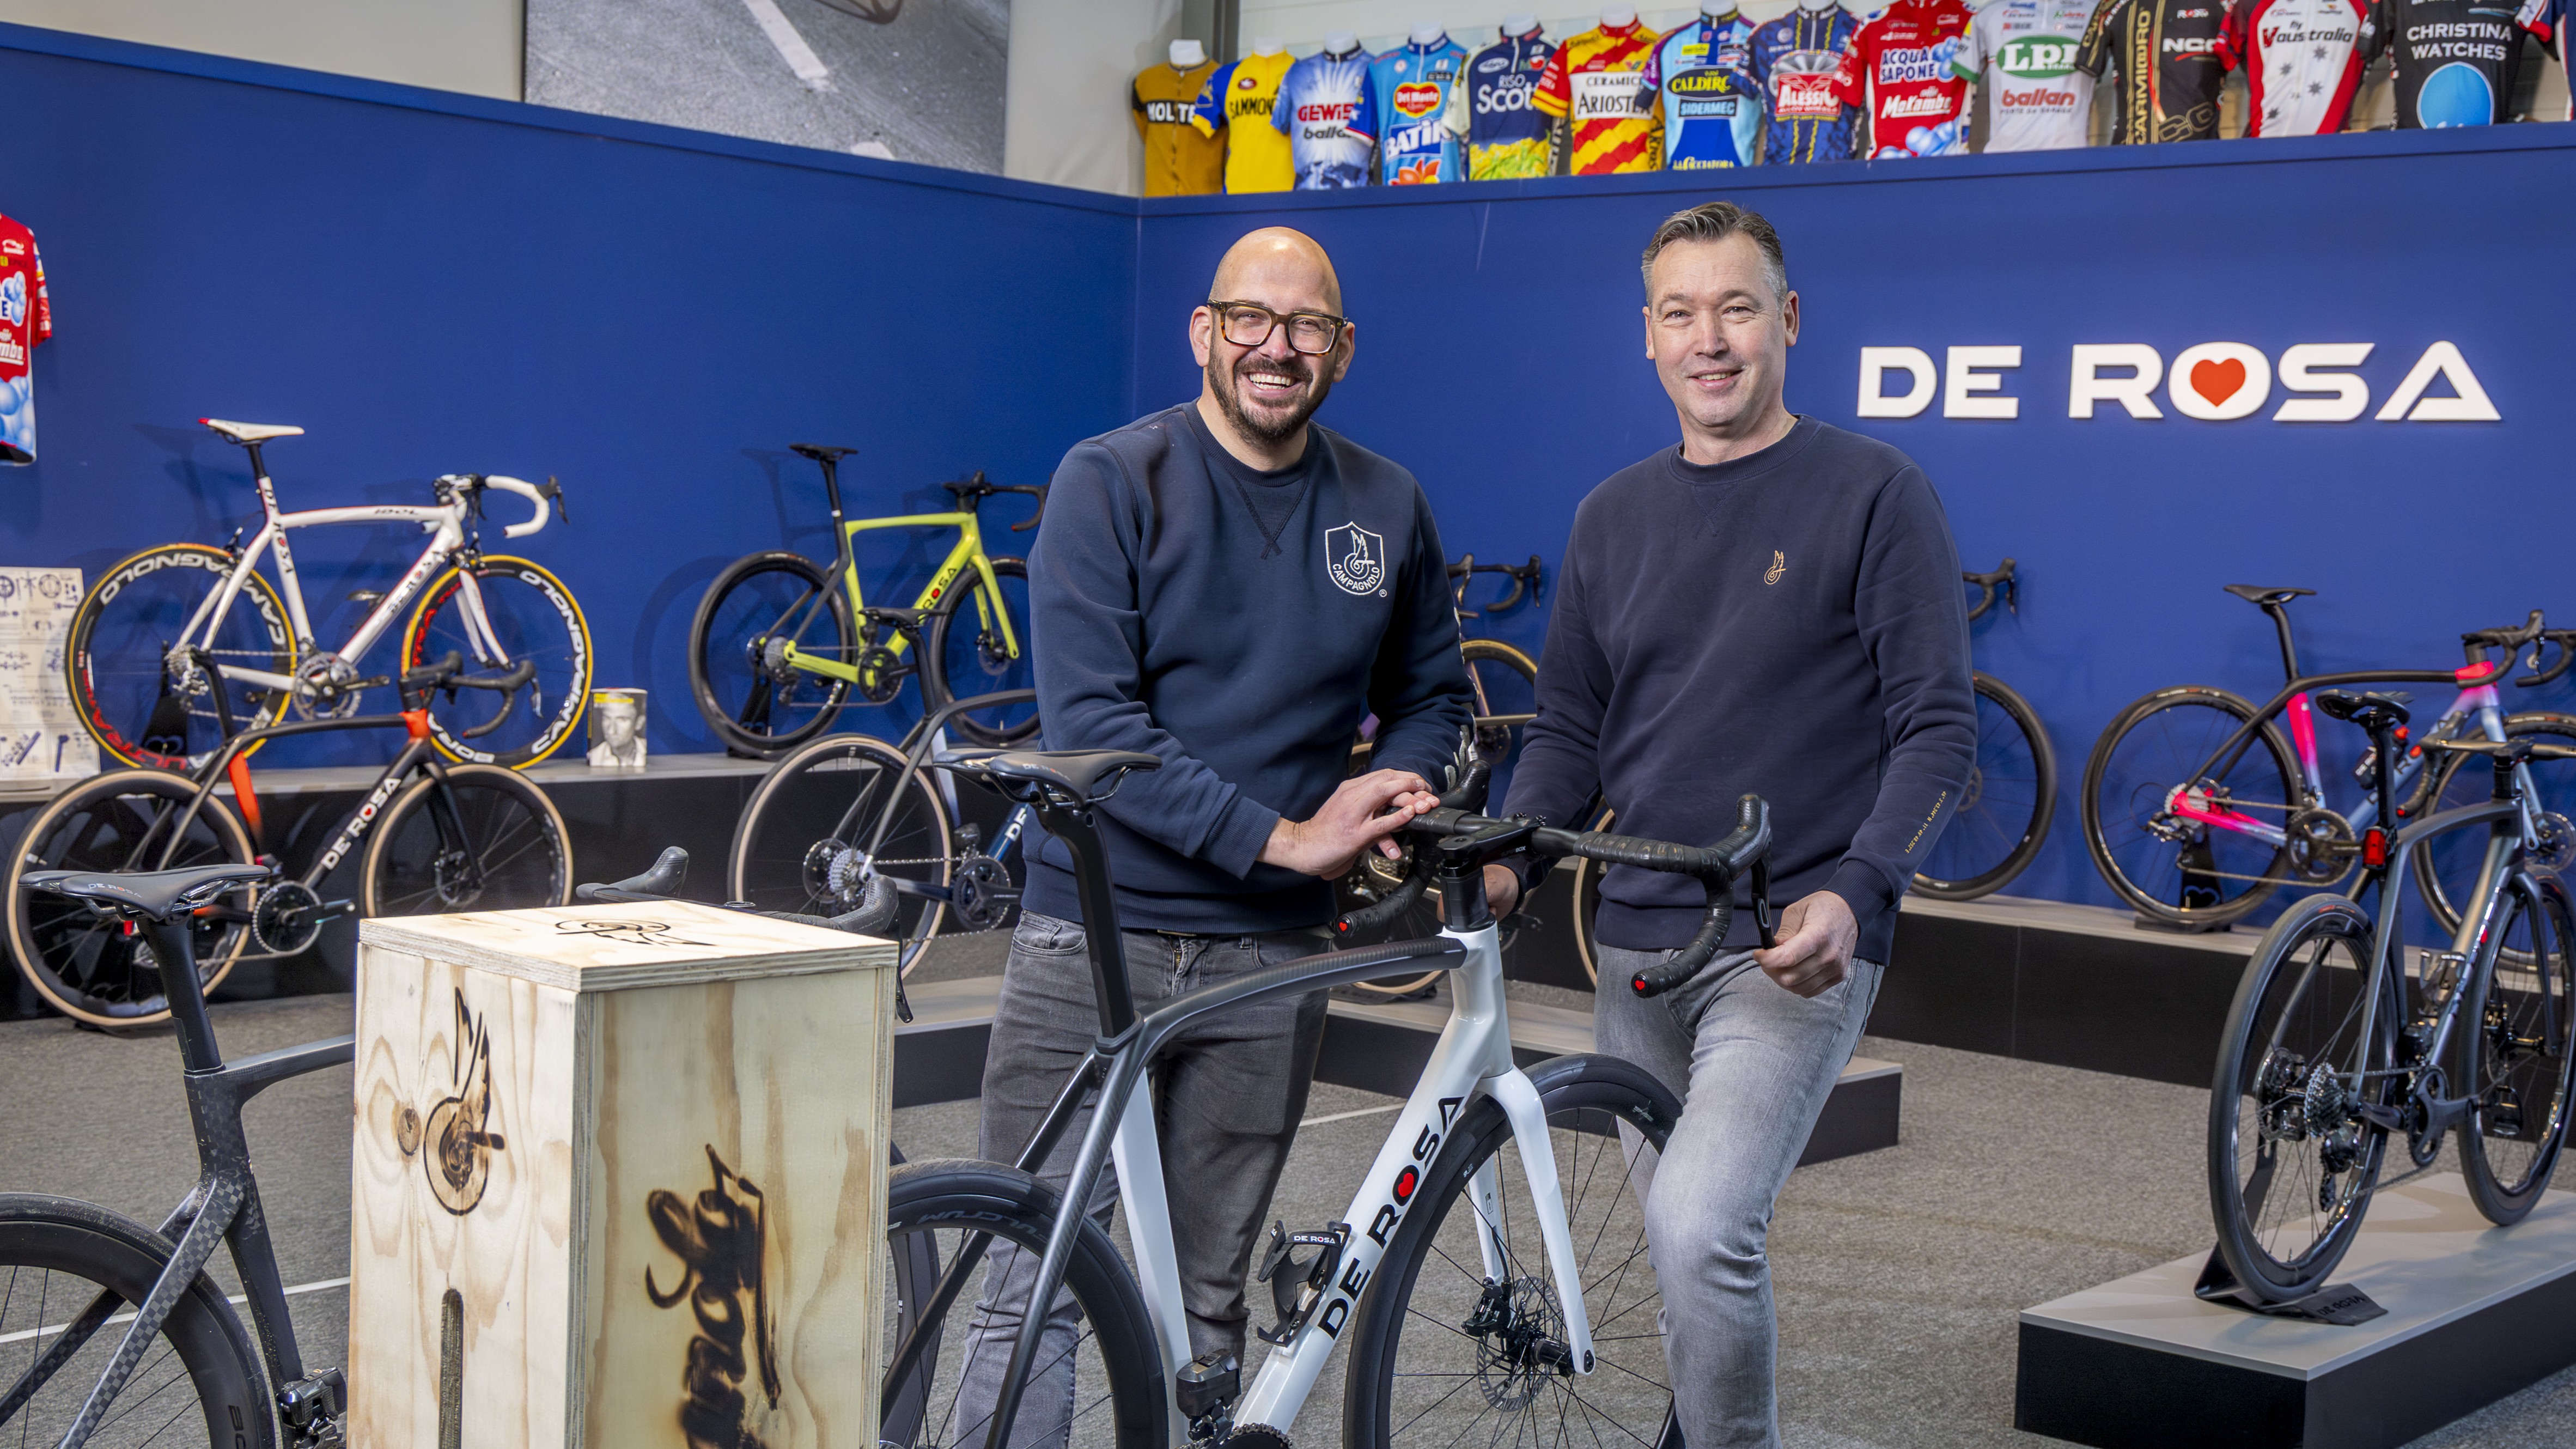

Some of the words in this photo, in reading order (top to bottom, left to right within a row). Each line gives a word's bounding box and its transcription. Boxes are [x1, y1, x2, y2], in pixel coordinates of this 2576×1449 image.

[2407, 23, 2512, 41] CHRISTINA
[1882, 48, 1929, 65] ACQUA
[2411, 42, 2507, 61] WATCHES
[1499, 74, 1526, 88] RISO
[1881, 64, 1935, 82] SAPONE
[1476, 81, 1538, 114] Scot
[2001, 88, 2076, 107] ballan
[1680, 101, 1735, 116] SIDERMEC
[1857, 345, 2022, 418] DE
[2068, 341, 2502, 422] ROSA
[1332, 563, 1380, 590] CAMPAGNOLO
[320, 840, 352, 870] DE
[346, 777, 401, 838] ROSA
[1004, 807, 1027, 841] DE
[1317, 1257, 1372, 1341] DE
[1366, 1096, 1465, 1250] ROSA
[1310, 1235, 1336, 1244] ROSA
